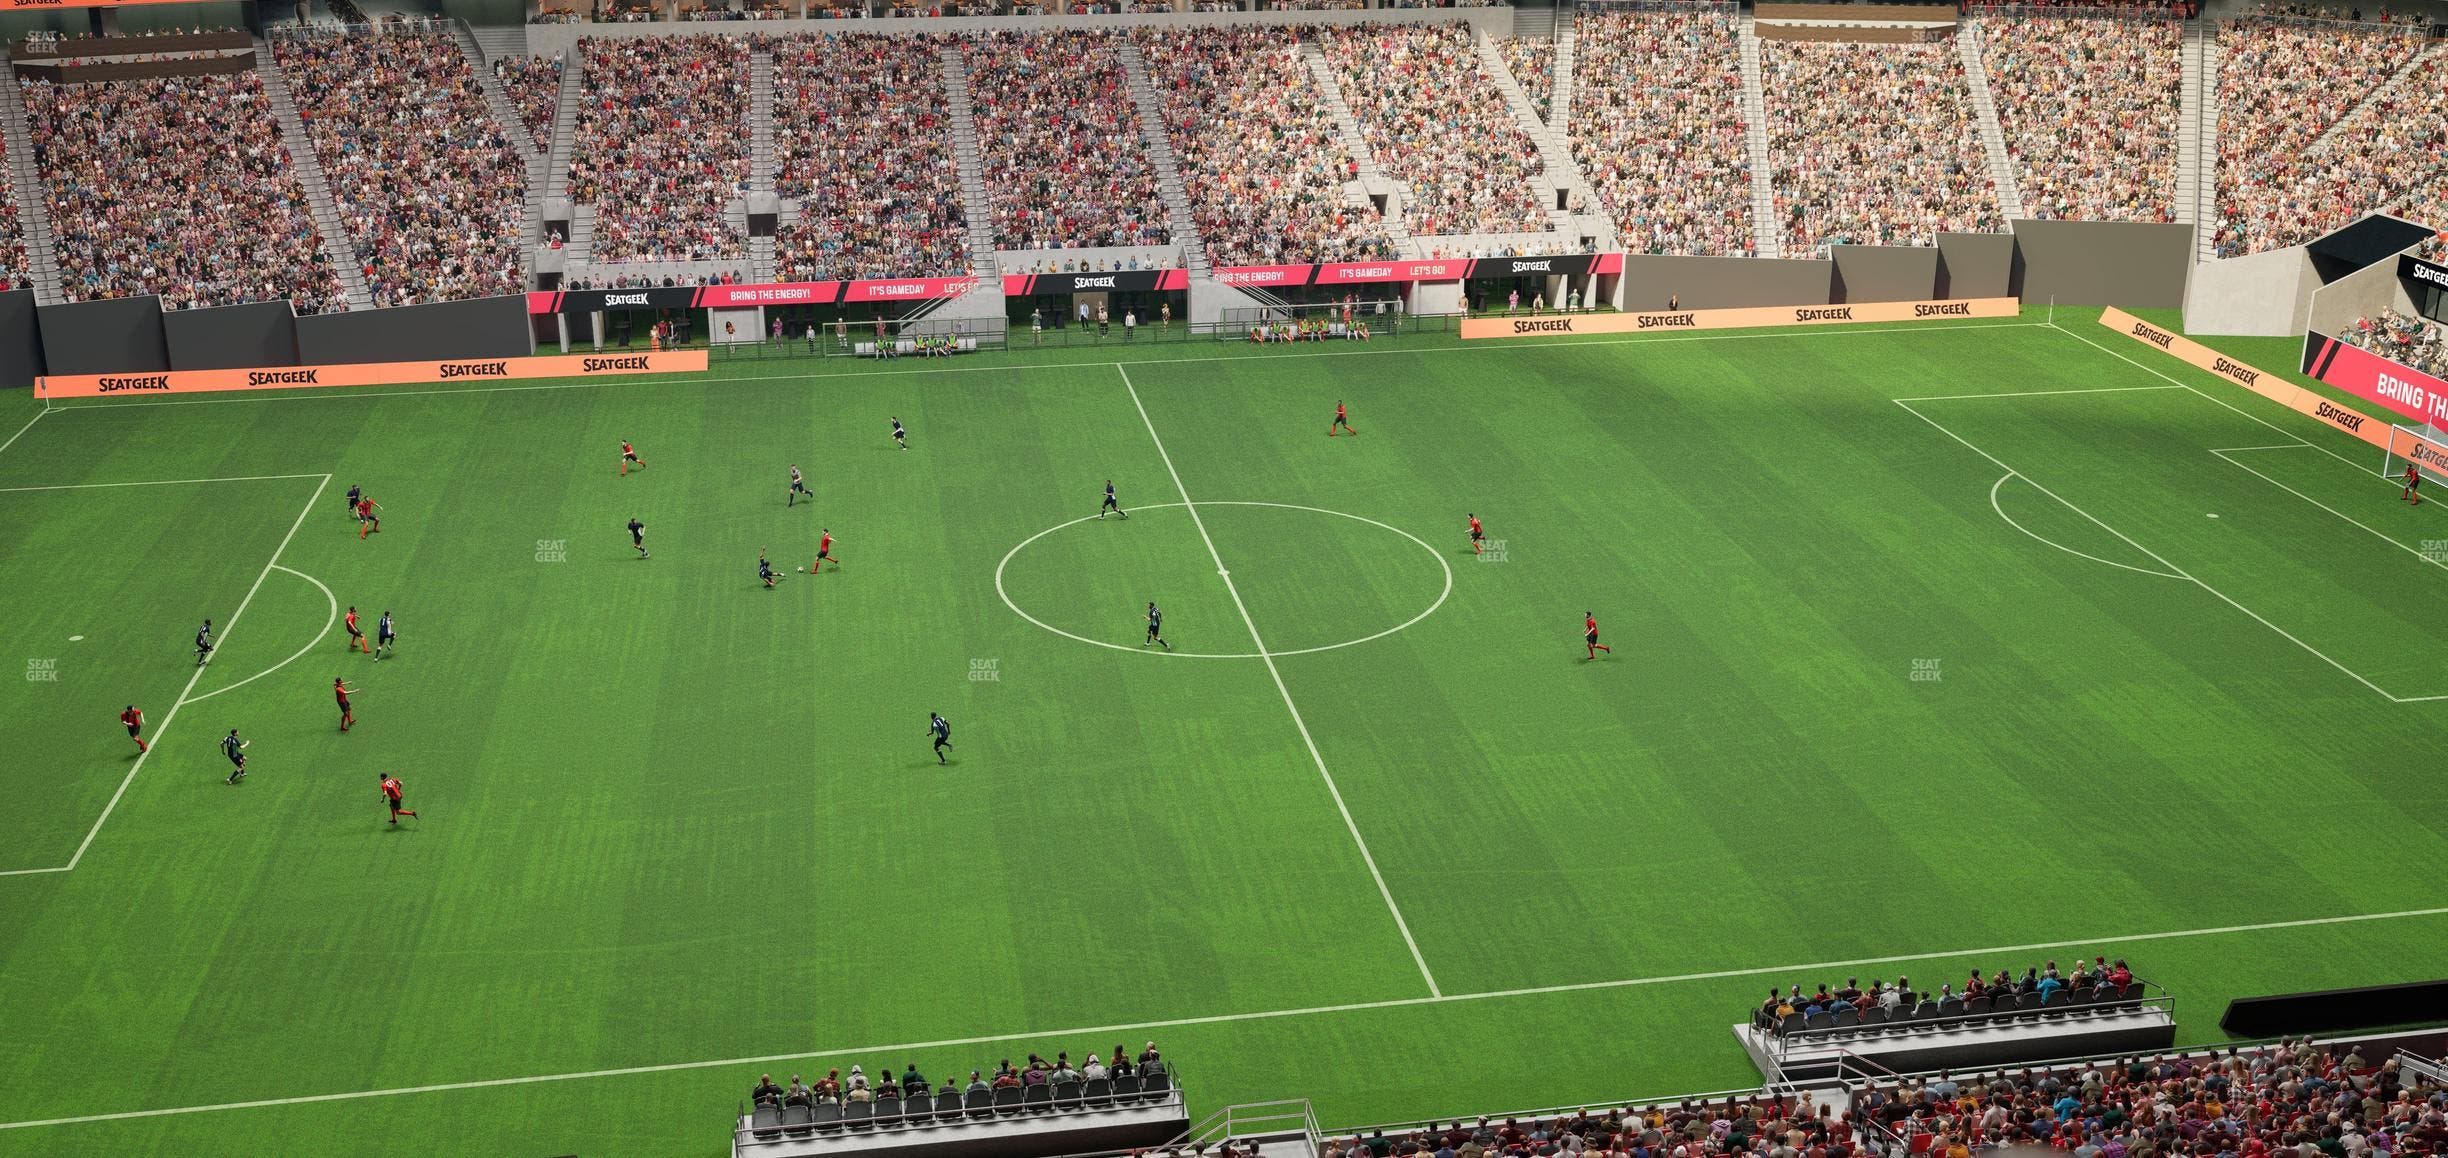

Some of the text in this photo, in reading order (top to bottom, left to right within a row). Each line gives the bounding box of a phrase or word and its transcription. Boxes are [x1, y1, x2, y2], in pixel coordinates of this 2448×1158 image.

[1340, 267, 1392, 278] IT'S GAMEDAY
[1410, 265, 1446, 276] LET'S GO!
[1512, 260, 1551, 272] SEATGEEK
[1074, 276, 1116, 289] SEATGEEK
[1251, 272, 1284, 281] ENERGY!
[730, 289, 811, 301] BRING THE ENERGY!
[869, 284, 925, 296] IT'S GAMEDAY
[605, 292, 649, 306] SEATGEEK
[1796, 307, 1853, 322] SEATGEEK
[1915, 302, 1970, 317] SEATGEEK
[1514, 318, 1573, 333] SEATGEEK
[1638, 314, 1695, 329] SEATGEEK
[2132, 322, 2174, 350] SEATGEEK
[440, 362, 508, 378] SEATGEEK
[584, 356, 650, 372] SEATGEEK
[249, 369, 318, 386] SEATGEEK
[2213, 358, 2260, 387] SEATGEEK
[99, 376, 169, 392] SEATGEEK
[2377, 372, 2424, 409] BRING
[2316, 402, 2365, 433] SEATGEEK
